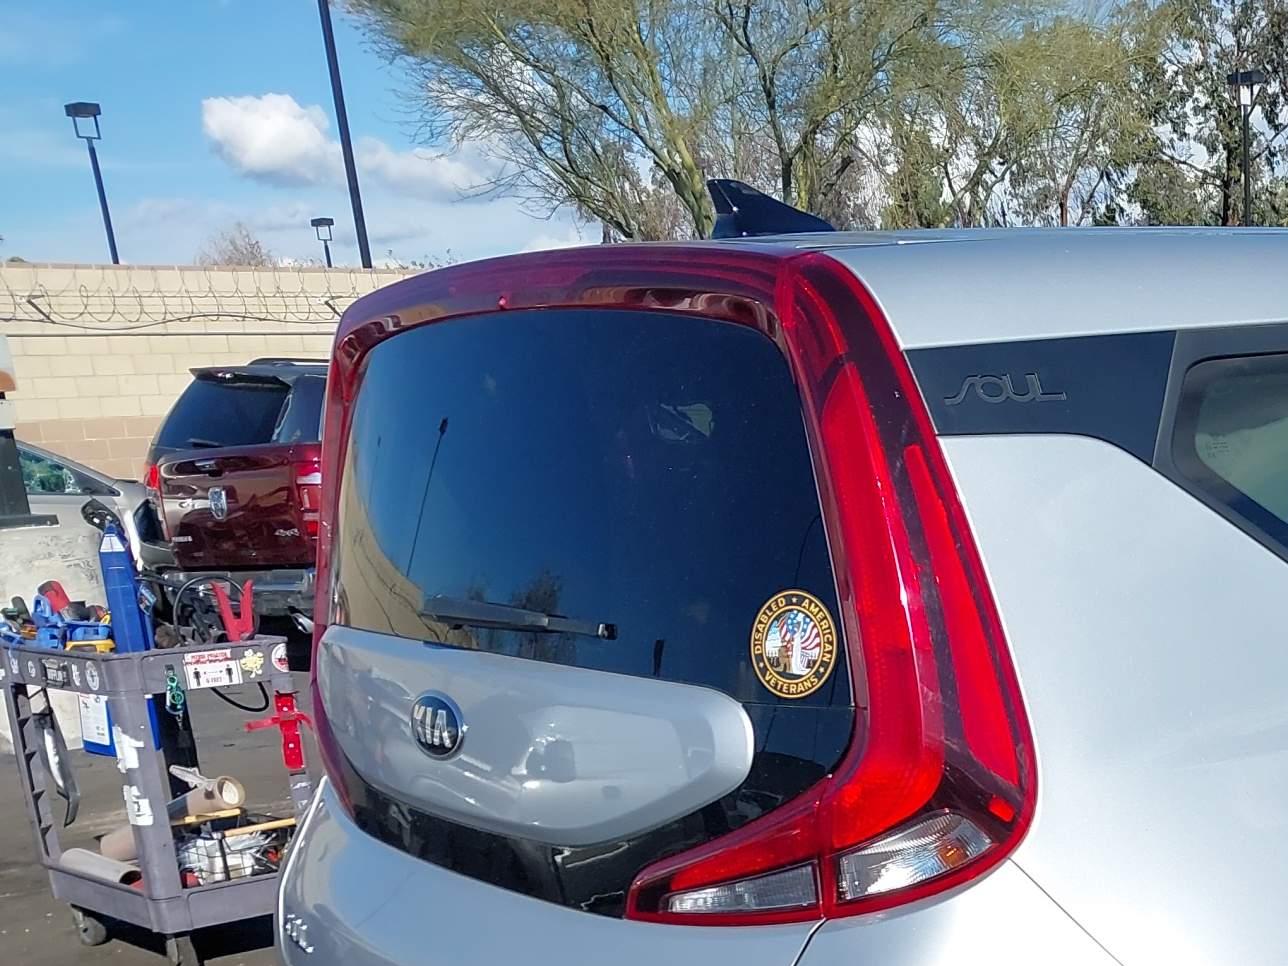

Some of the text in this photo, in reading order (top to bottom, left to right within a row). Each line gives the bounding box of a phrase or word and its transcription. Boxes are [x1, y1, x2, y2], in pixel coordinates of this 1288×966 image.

[943, 372, 1067, 405] SOUL
[754, 597, 832, 662] DISABLED AMERICAN
[763, 670, 820, 694] VETERANS
[413, 704, 452, 748] KIA
